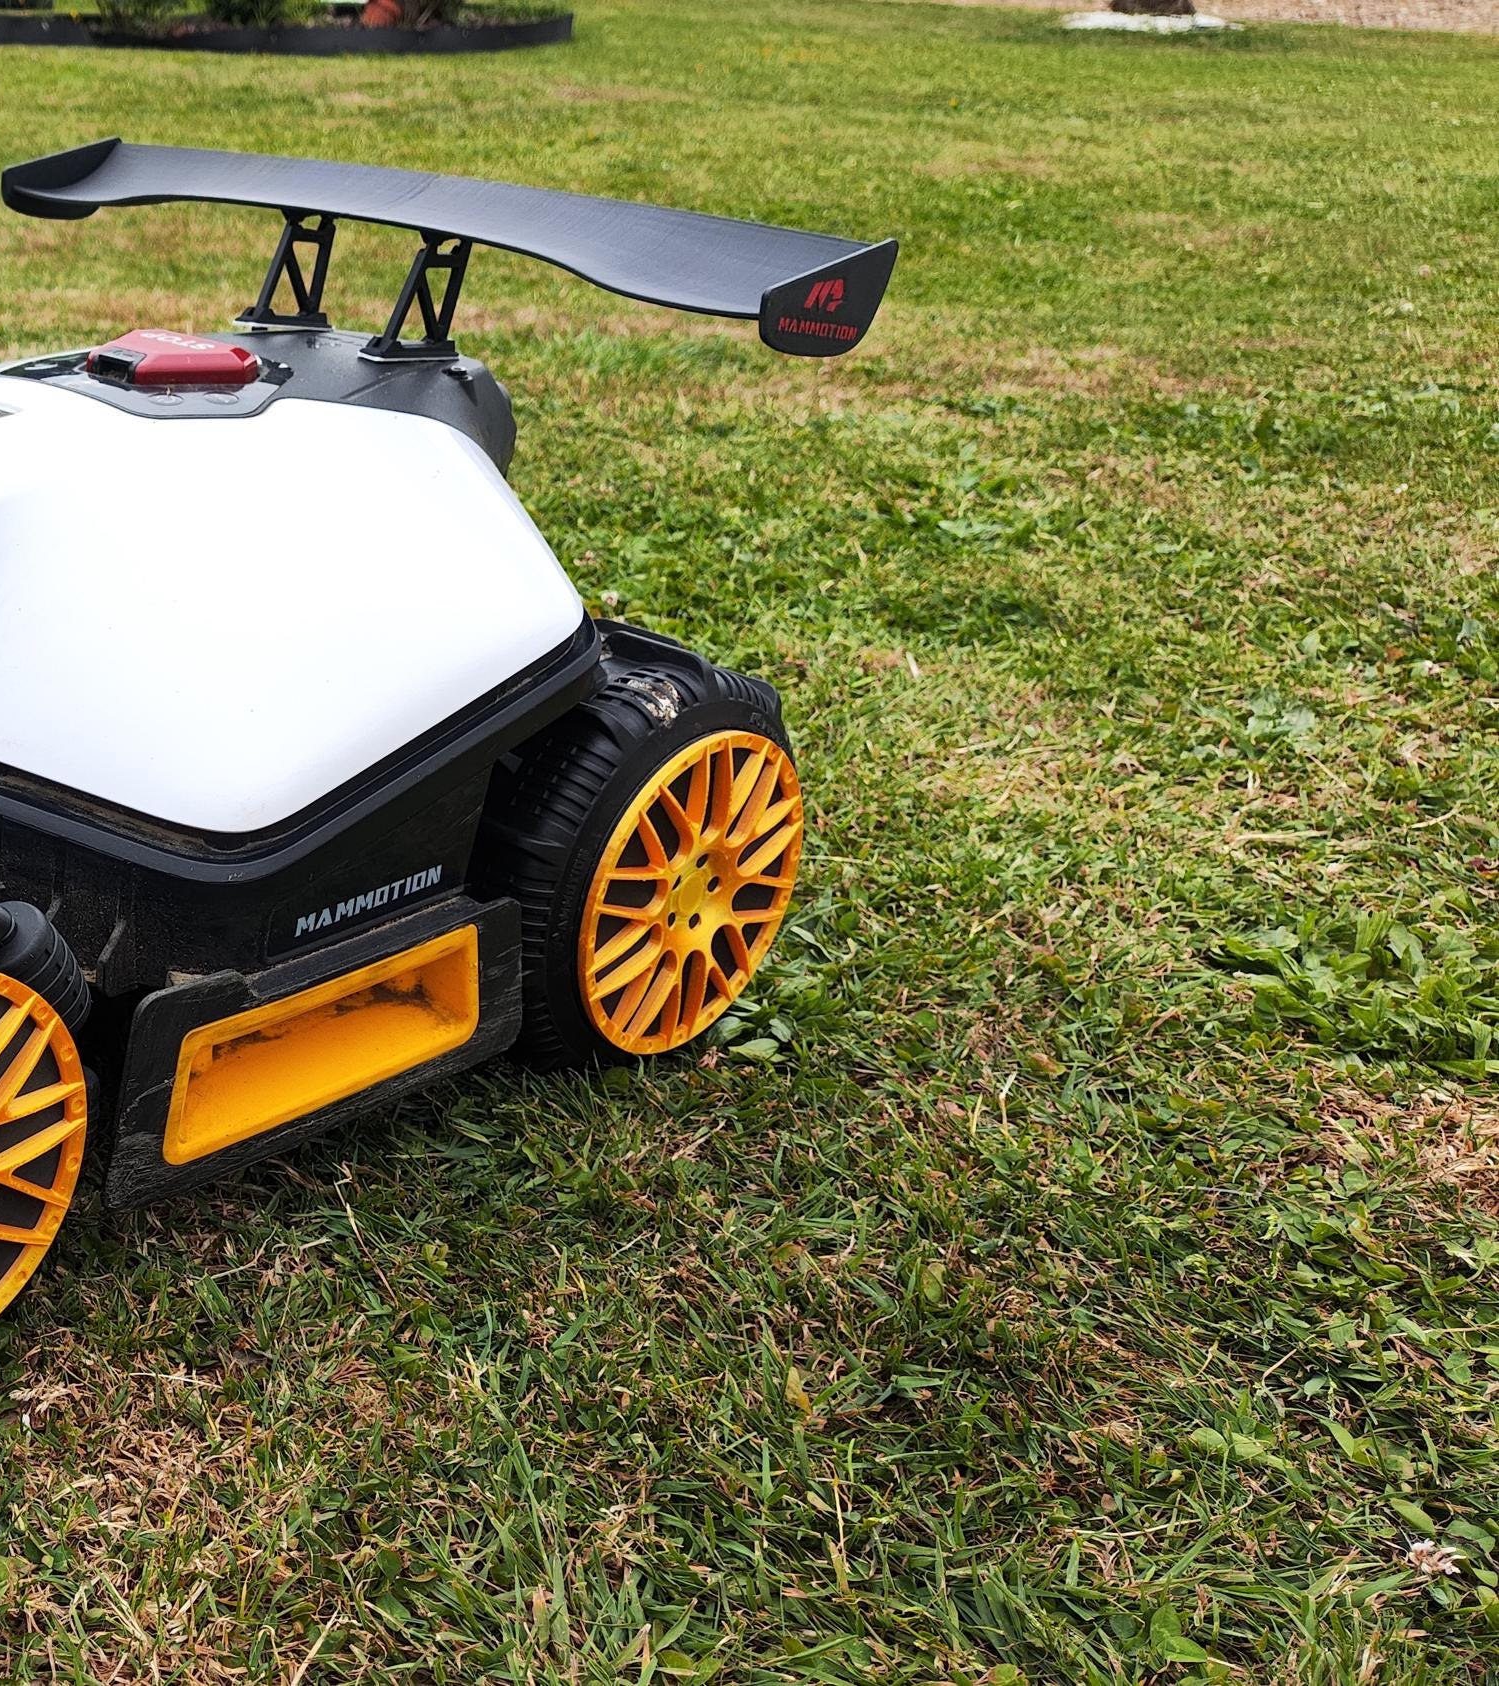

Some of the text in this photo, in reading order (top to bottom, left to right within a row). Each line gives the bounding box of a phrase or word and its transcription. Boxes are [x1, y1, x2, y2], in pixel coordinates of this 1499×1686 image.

[778, 317, 858, 341] MAMMOTION
[139, 332, 216, 351] STOP
[294, 864, 443, 938] MAMMOTION
